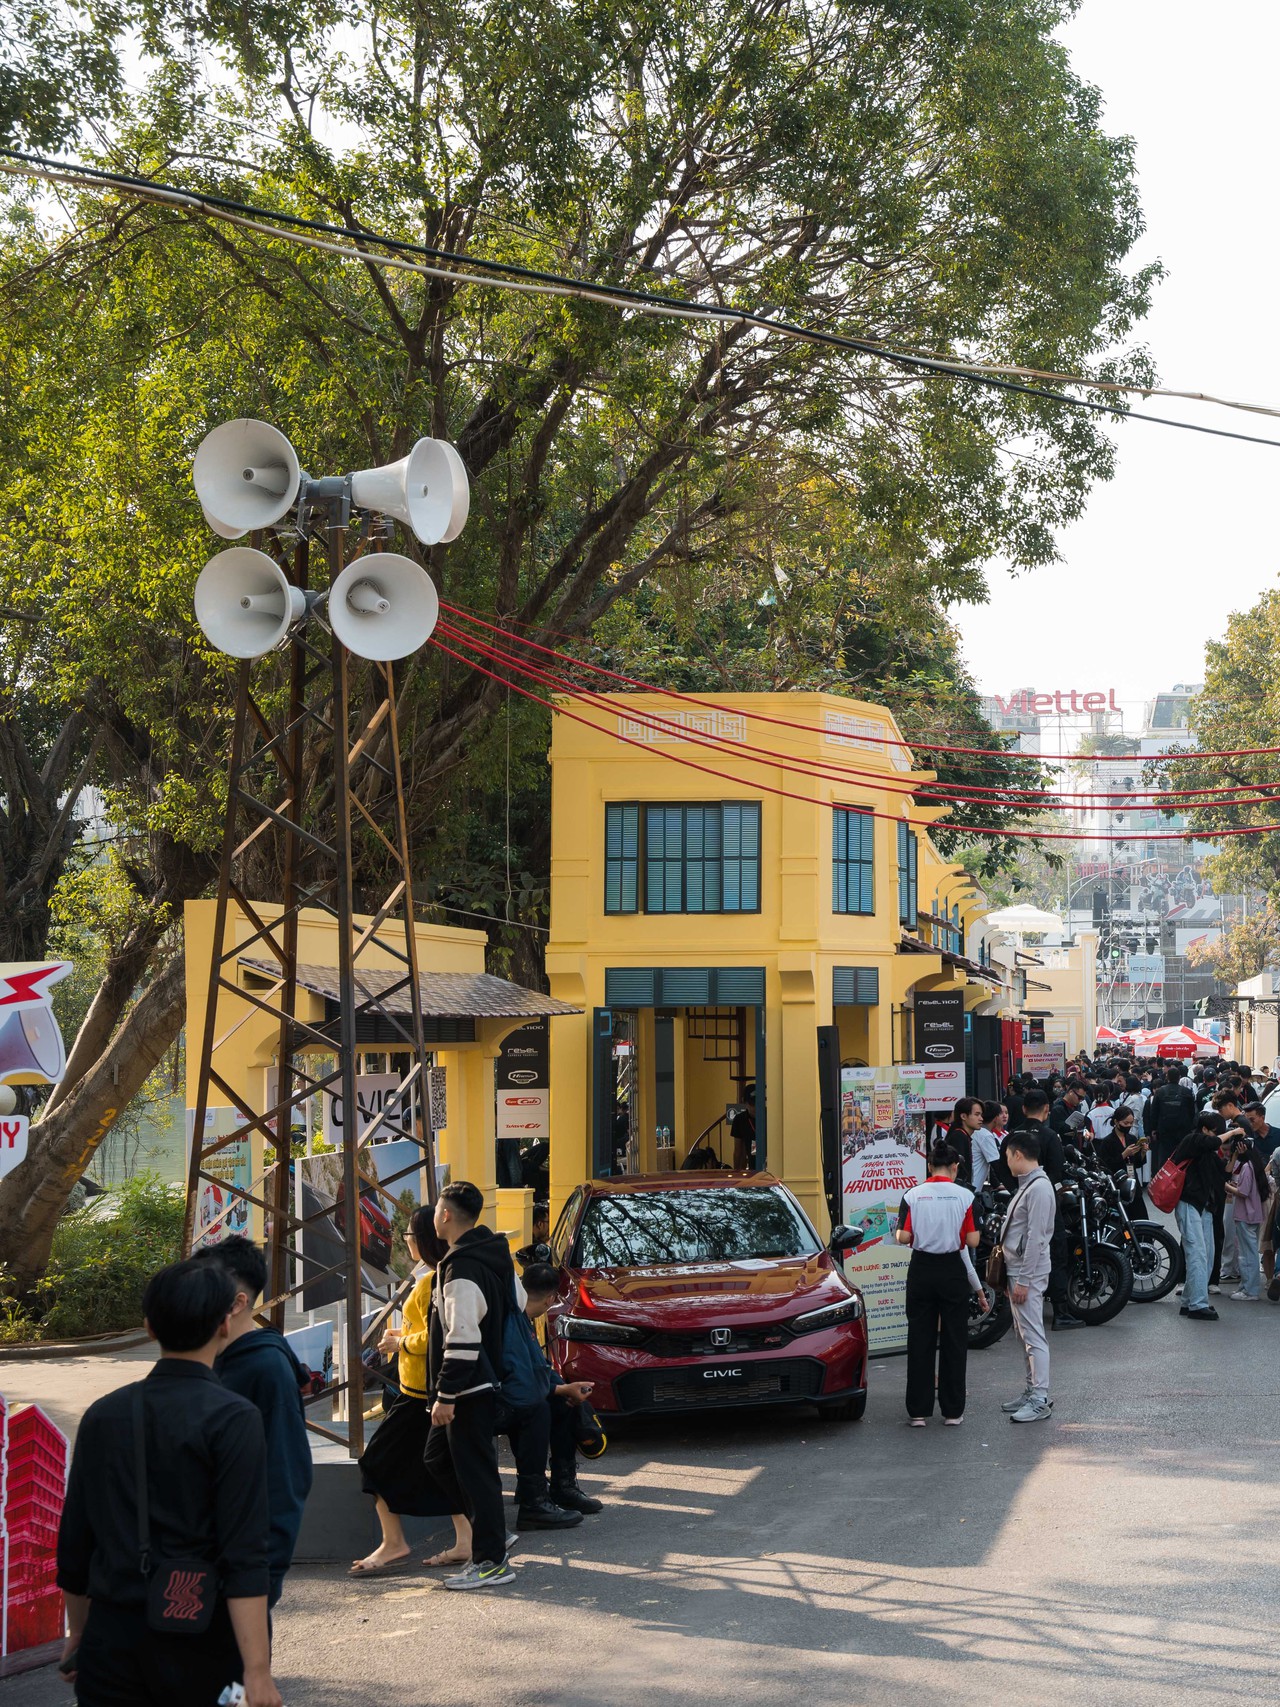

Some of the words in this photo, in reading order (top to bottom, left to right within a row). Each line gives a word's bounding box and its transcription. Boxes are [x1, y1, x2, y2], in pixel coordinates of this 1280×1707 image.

[994, 688, 1122, 715] viettel
[331, 1088, 400, 1127] CVIC
[887, 1168, 904, 1176] TAY
[843, 1176, 918, 1194] HANDMADE
[703, 1368, 742, 1378] CIVIC
